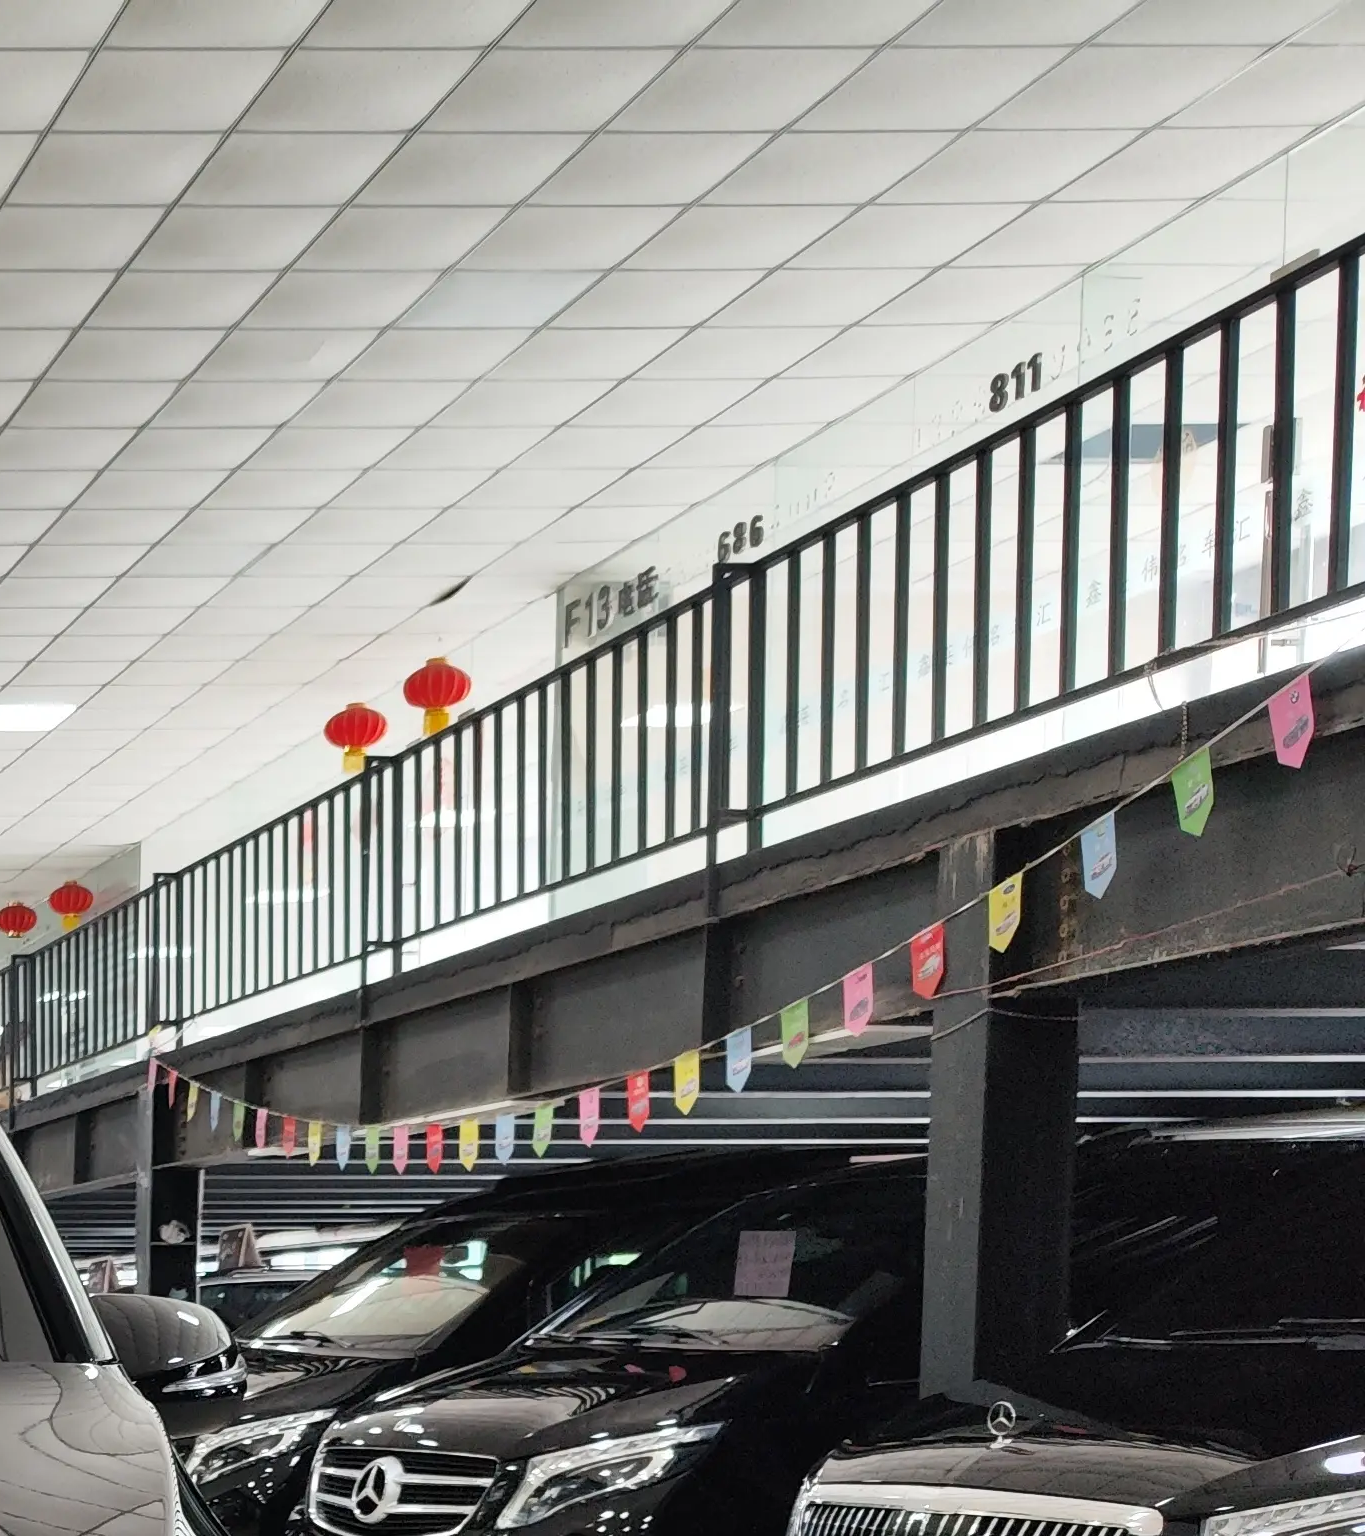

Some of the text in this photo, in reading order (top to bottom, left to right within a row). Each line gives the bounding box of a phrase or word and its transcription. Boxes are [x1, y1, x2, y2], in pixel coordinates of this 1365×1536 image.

[988, 352, 1043, 413] 811
[717, 514, 764, 564] 686
[564, 584, 612, 649] F13
